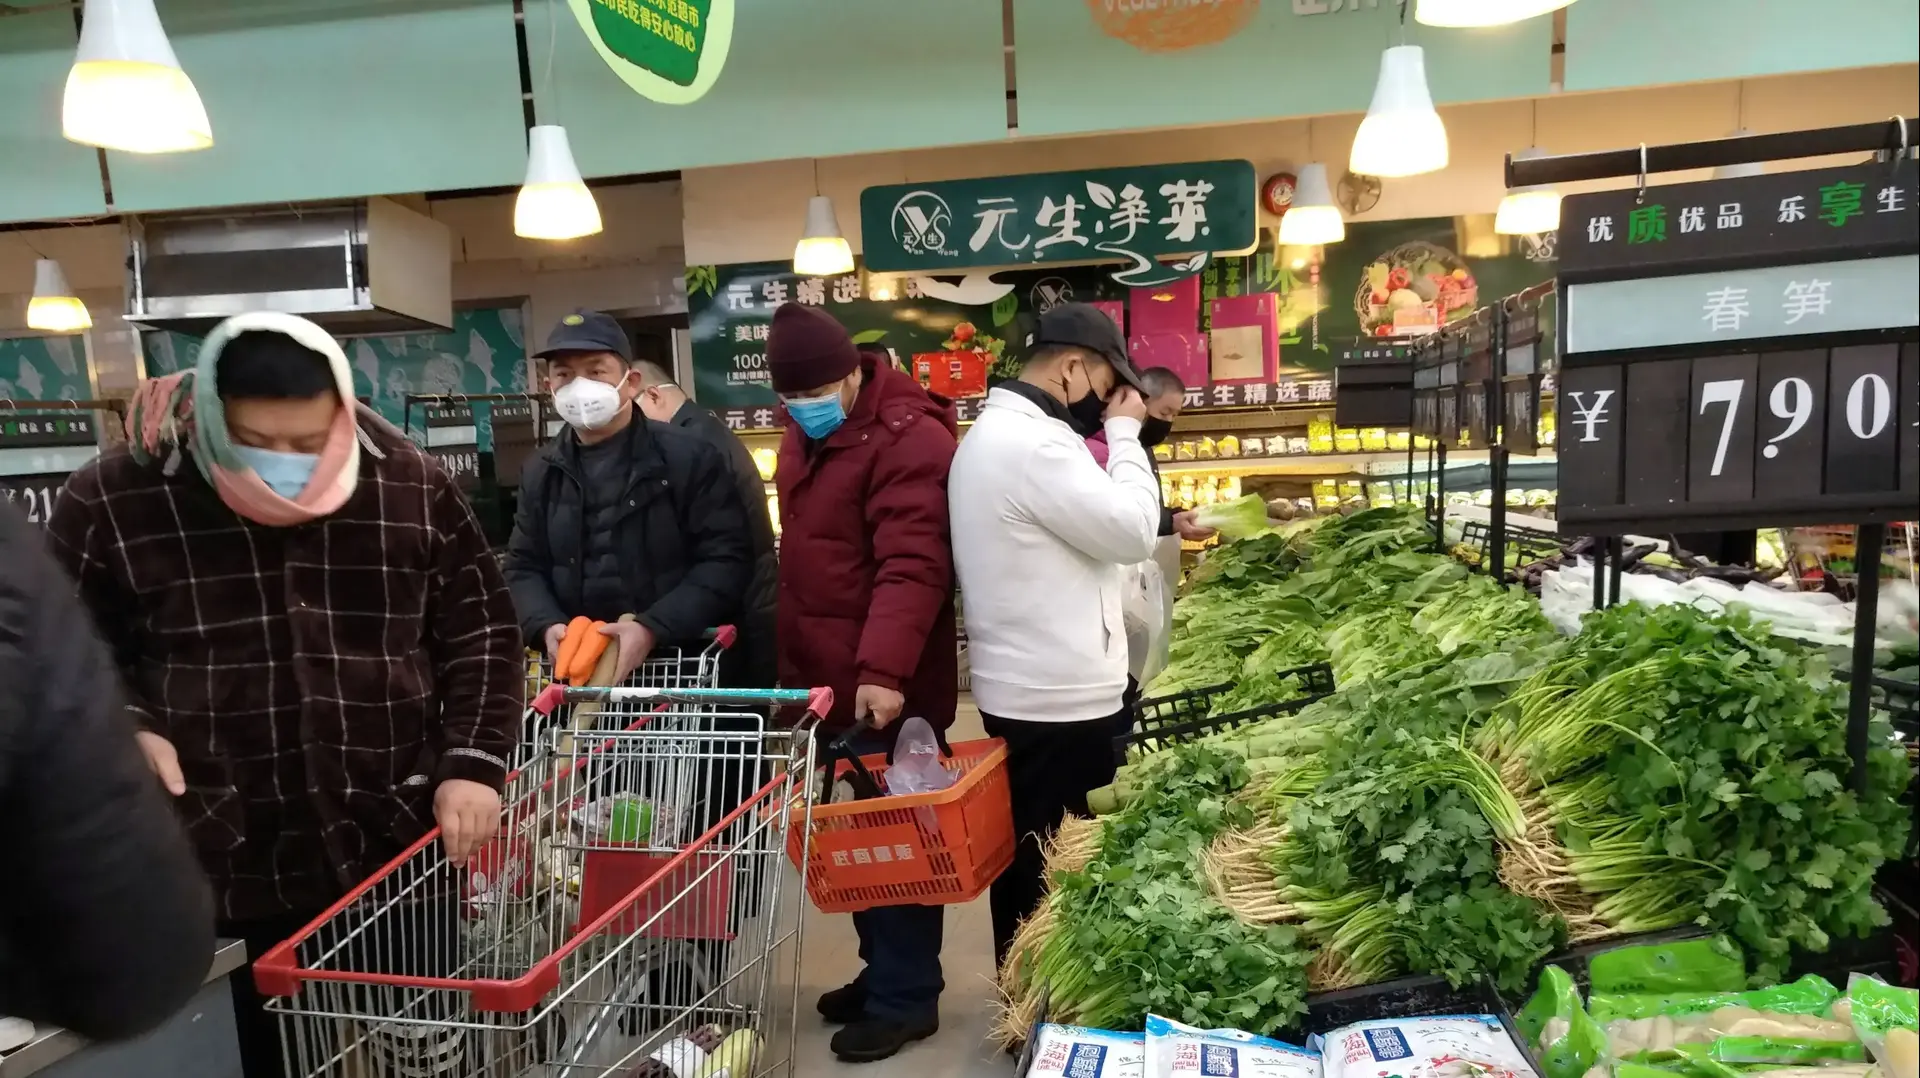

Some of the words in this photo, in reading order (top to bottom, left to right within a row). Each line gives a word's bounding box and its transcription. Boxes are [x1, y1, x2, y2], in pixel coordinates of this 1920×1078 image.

[645, 0, 699, 27] 示范超市
[968, 179, 1215, 254] 元生净菜
[1587, 202, 1743, 245] 优质优品
[1778, 181, 1919, 227] 乐享生
[1702, 278, 1832, 332] 春笋
[735, 324, 770, 341] 美味
[725, 408, 773, 430] 元生
[1568, 390, 1616, 442] ¥
[1700, 373, 1891, 476] 7.90
[23, 486, 66, 523] 21
[1043, 1040, 1069, 1061] 洪湖
